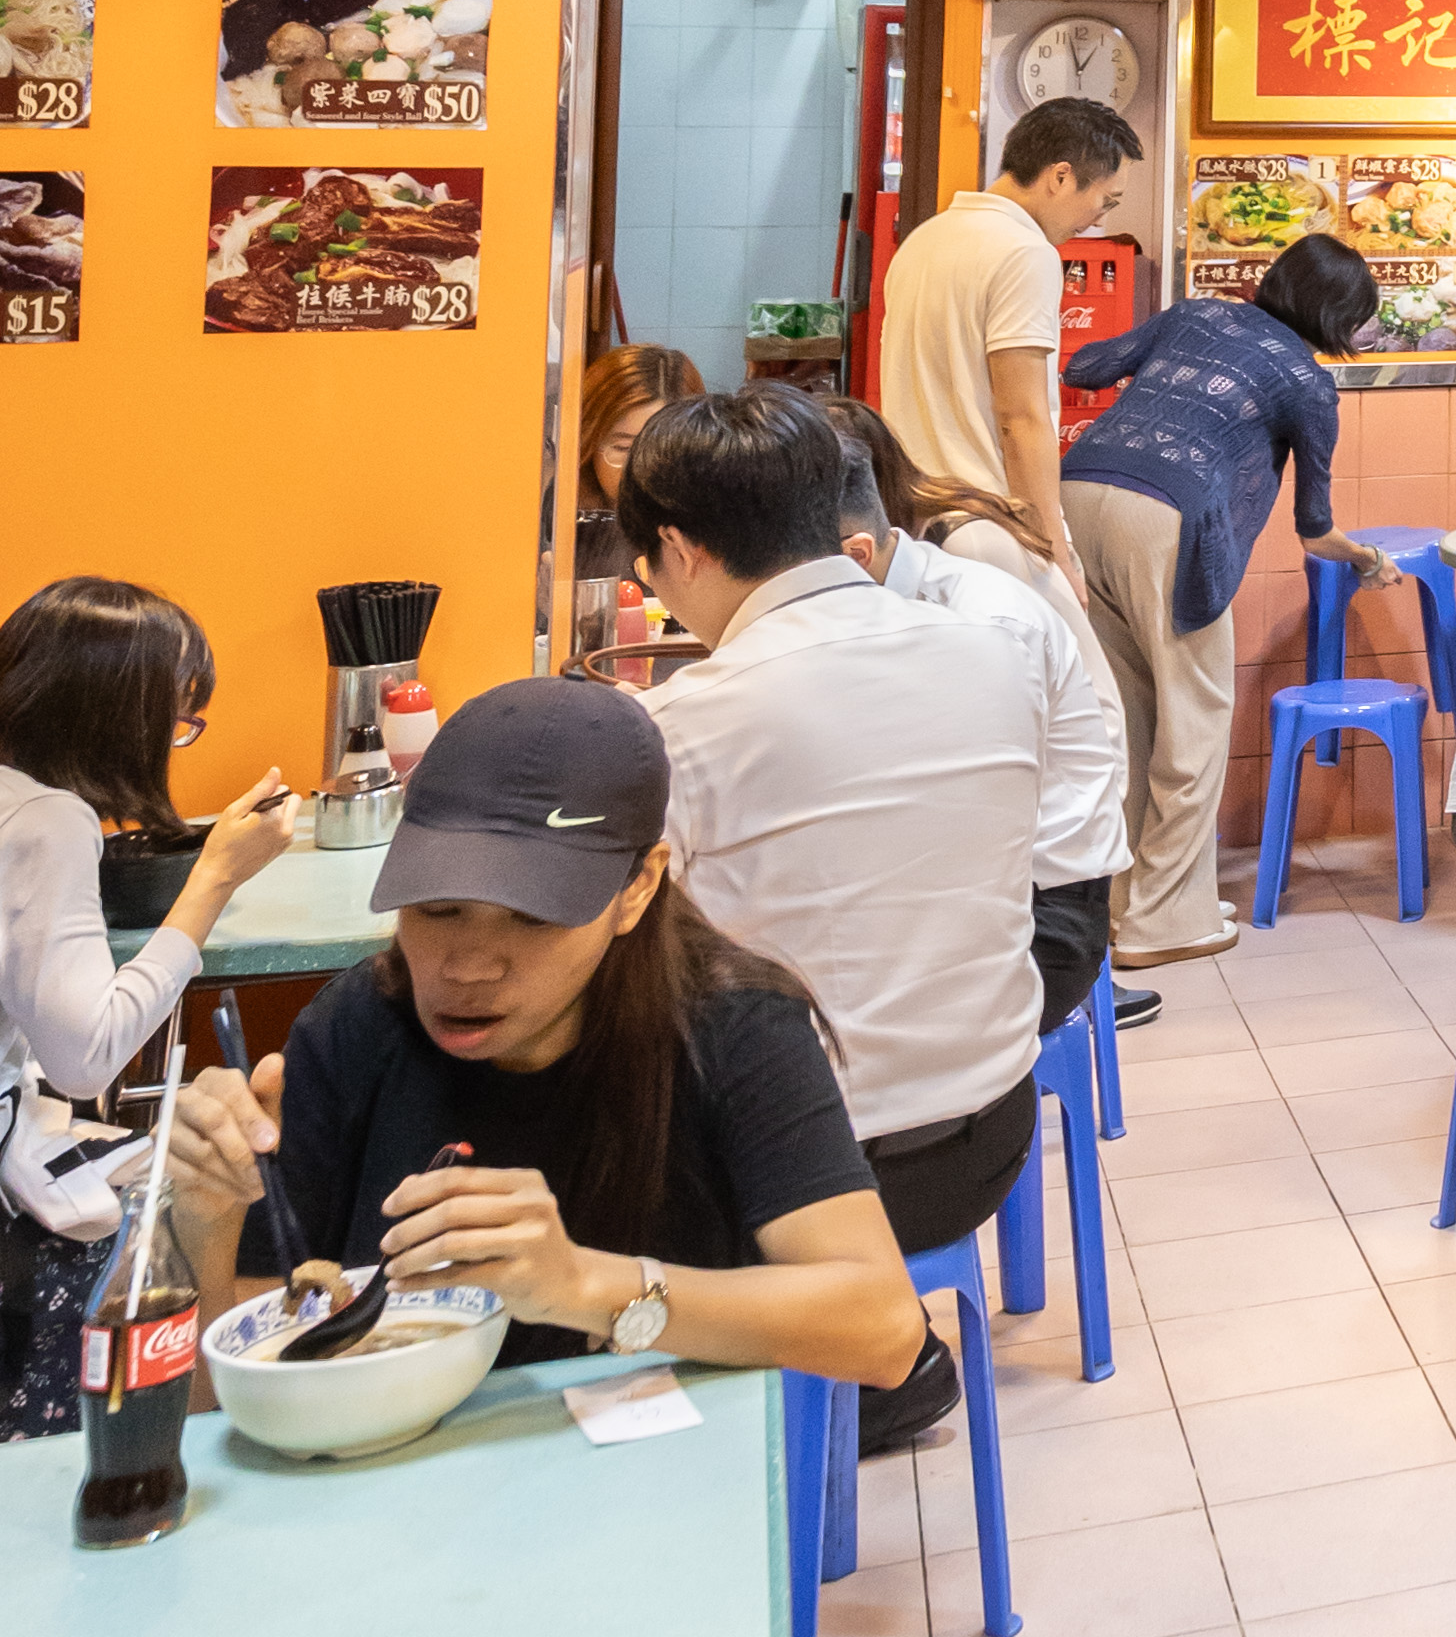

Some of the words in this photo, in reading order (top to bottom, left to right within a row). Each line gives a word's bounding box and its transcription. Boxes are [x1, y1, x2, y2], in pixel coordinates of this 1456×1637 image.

[1055, 30, 1066, 45] 11
[1074, 26, 1088, 41] 12
[1100, 33, 1104, 46] 1
[1038, 45, 1052, 59] 10
[1111, 48, 1121, 63] 2
[1030, 63, 1041, 78] 9
[1116, 68, 1127, 82] 3
[1035, 84, 1045, 98] 8
[1109, 87, 1119, 100] 4
[17, 80, 79, 121] $28
[309, 81, 421, 111] 紫菜四寶
[423, 83, 481, 122] $50
[1257, 158, 1288, 182] $28
[1318, 161, 1326, 179] 1
[1411, 158, 1441, 182] $28
[1408, 264, 1439, 285] $34
[296, 281, 411, 309] 柱候牛腩
[411, 284, 468, 323] $28
[7, 294, 69, 335] $15
